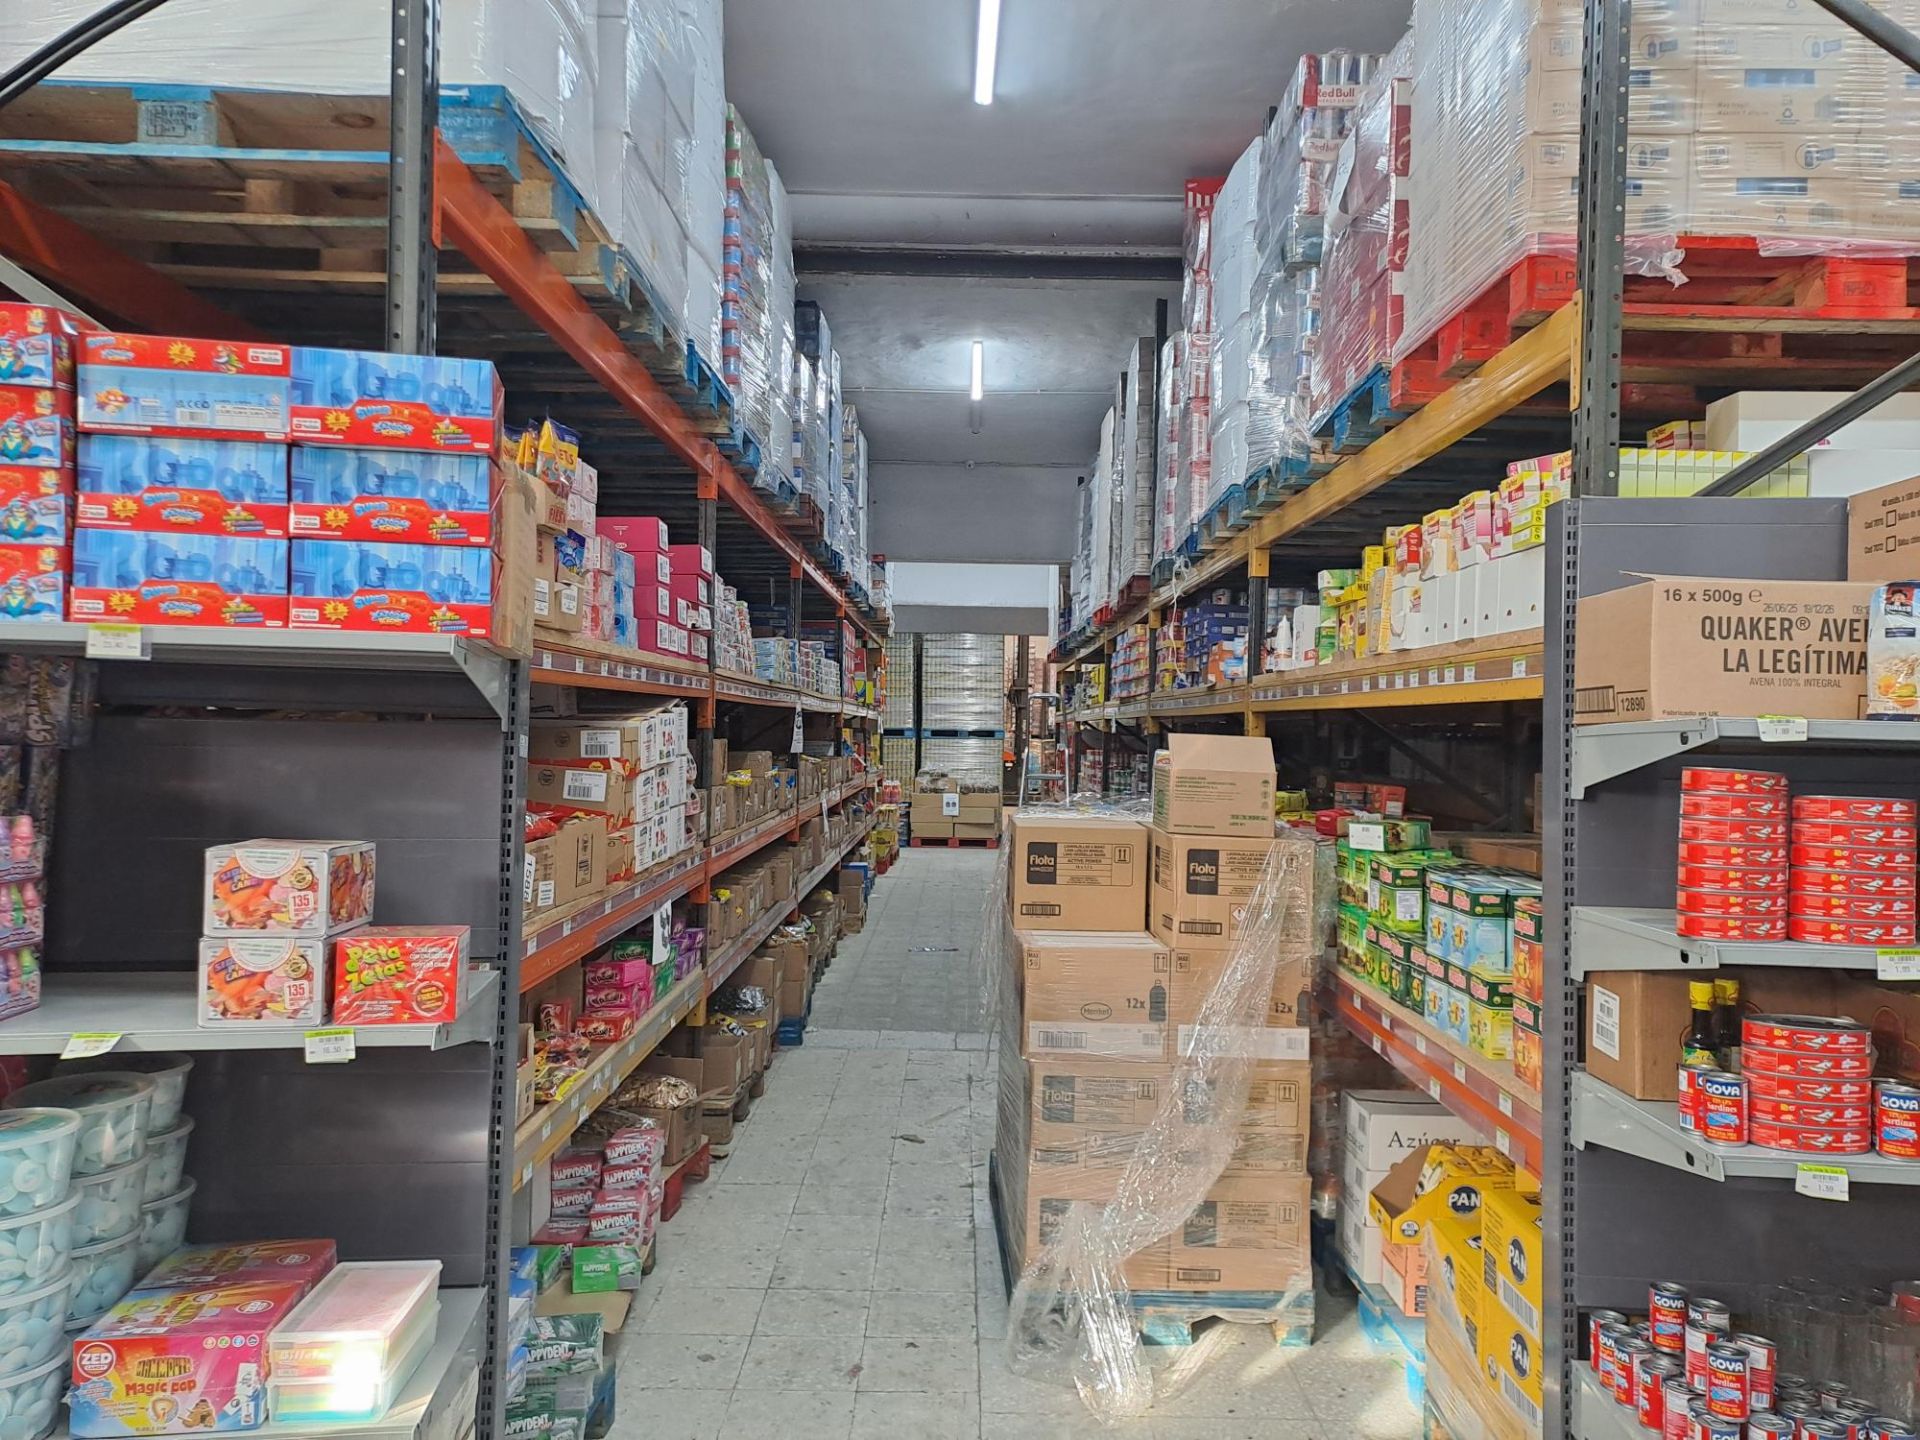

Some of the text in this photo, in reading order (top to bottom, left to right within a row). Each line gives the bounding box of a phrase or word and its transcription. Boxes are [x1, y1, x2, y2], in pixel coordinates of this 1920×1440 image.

[1335, 87, 1355, 98] Bull
[1663, 588, 1682, 602] 16
[1687, 591, 1698, 602] x
[1702, 588, 1743, 606] 500g
[1723, 644, 1868, 675] LA LEGÍTIMA
[1749, 677, 1842, 689] AVENA 100% INTEGRAL
[1620, 696, 1646, 713] 12890
[1029, 854, 1055, 866] Flota
[1189, 862, 1216, 875] Flota
[292, 894, 310, 907] 135
[345, 945, 401, 973] Peta
[287, 983, 305, 997] 135
[1125, 997, 1146, 1009] 12x
[1274, 1002, 1293, 1014] 12x
[1705, 1081, 1741, 1097] GOYA
[1706, 1101, 1738, 1113] Sardines
[1881, 1095, 1919, 1110] GOYA
[606, 1143, 646, 1160] HAPPYDENT
[553, 1164, 594, 1181] HAPPYDENT
[603, 1167, 644, 1185] HAPPYDENT
[552, 1191, 593, 1208] HAPPYDENT
[1448, 1192, 1481, 1208] PAN
[591, 1214, 634, 1232] HAPPYDENT
[1654, 1295, 1686, 1309] GOYA
[81, 1352, 113, 1365] ZED
[527, 1343, 570, 1362] APPYDENT
[1510, 1337, 1531, 1376] PAN
[1708, 1356, 1744, 1372] GOYA
[125, 1381, 168, 1396] Magic
[504, 1413, 550, 1436] APPYDENT
